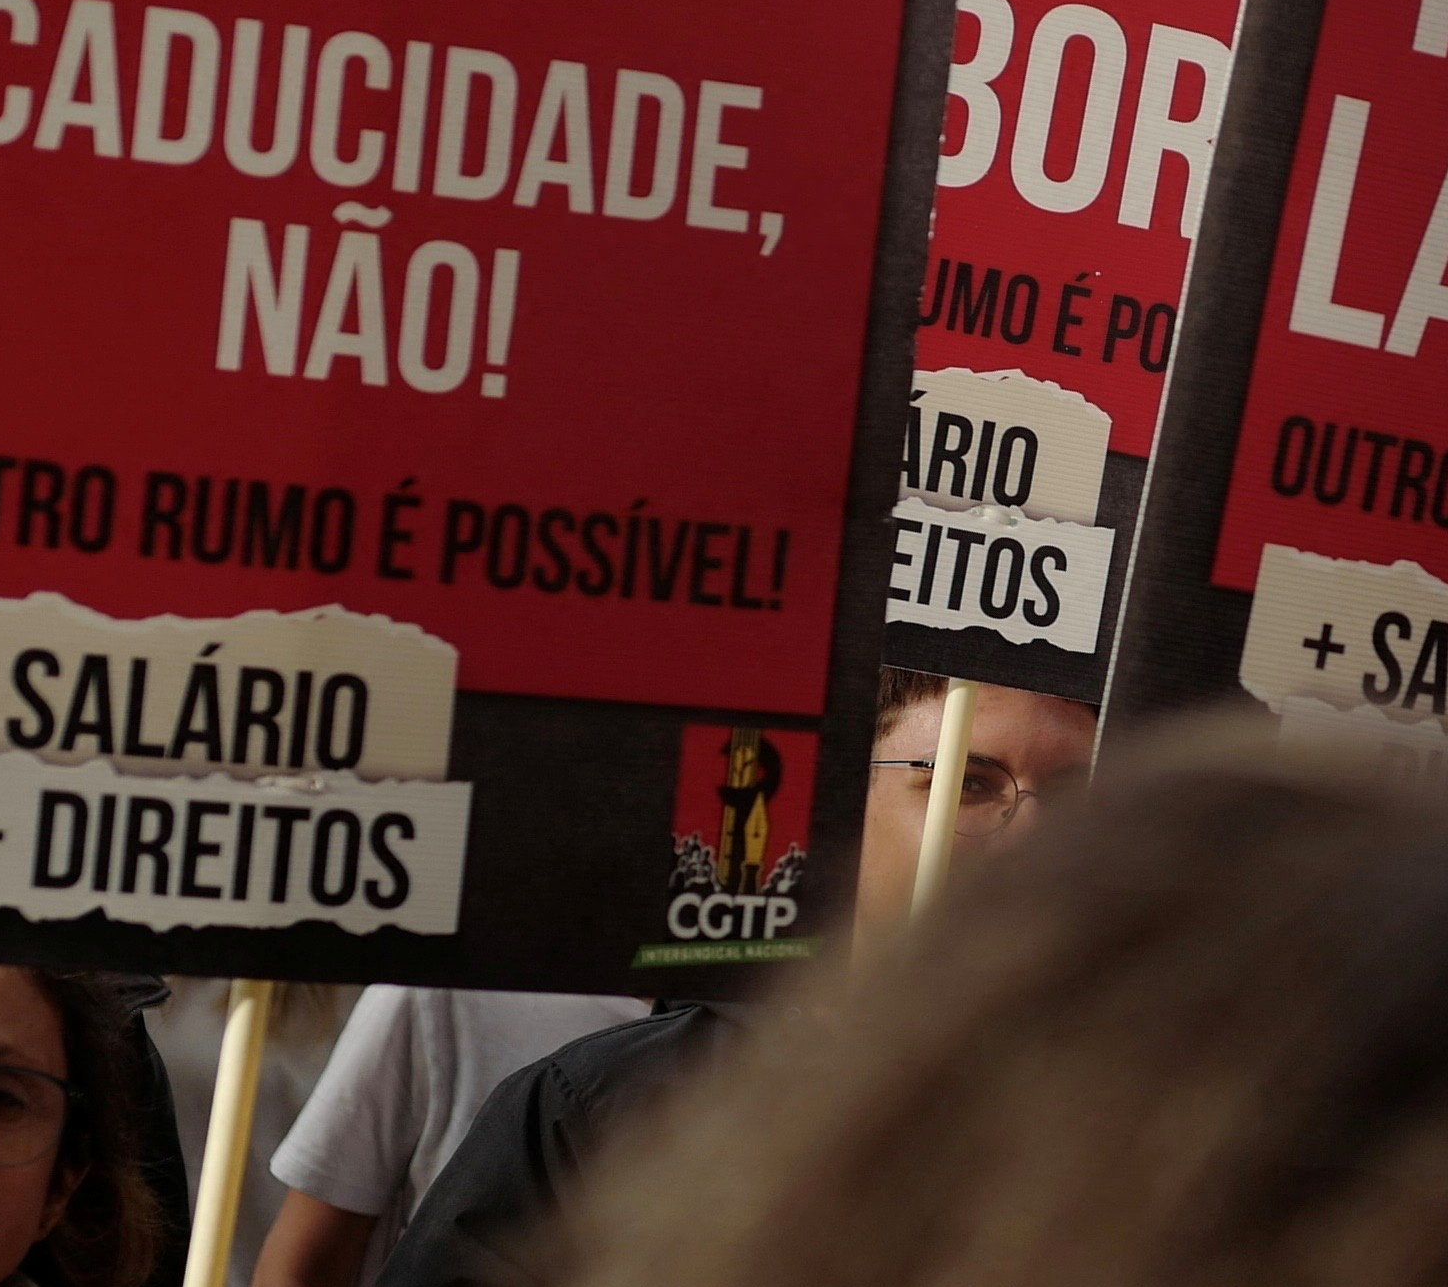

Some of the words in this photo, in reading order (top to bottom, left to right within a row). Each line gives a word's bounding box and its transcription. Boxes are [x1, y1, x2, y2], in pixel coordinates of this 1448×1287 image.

[215, 201, 522, 399] NÃO!
[1053, 270, 1092, 359] É
[900, 390, 1040, 508] ÁRIO
[139, 471, 353, 575] RUMO
[376, 476, 415, 580] É
[440, 499, 790, 613] POSSÍVEL!
[886, 519, 1068, 628] EITOS
[5, 643, 369, 773] SALÁRIO
[33, 789, 414, 910] DIREITOS
[667, 892, 799, 940] CGTP
